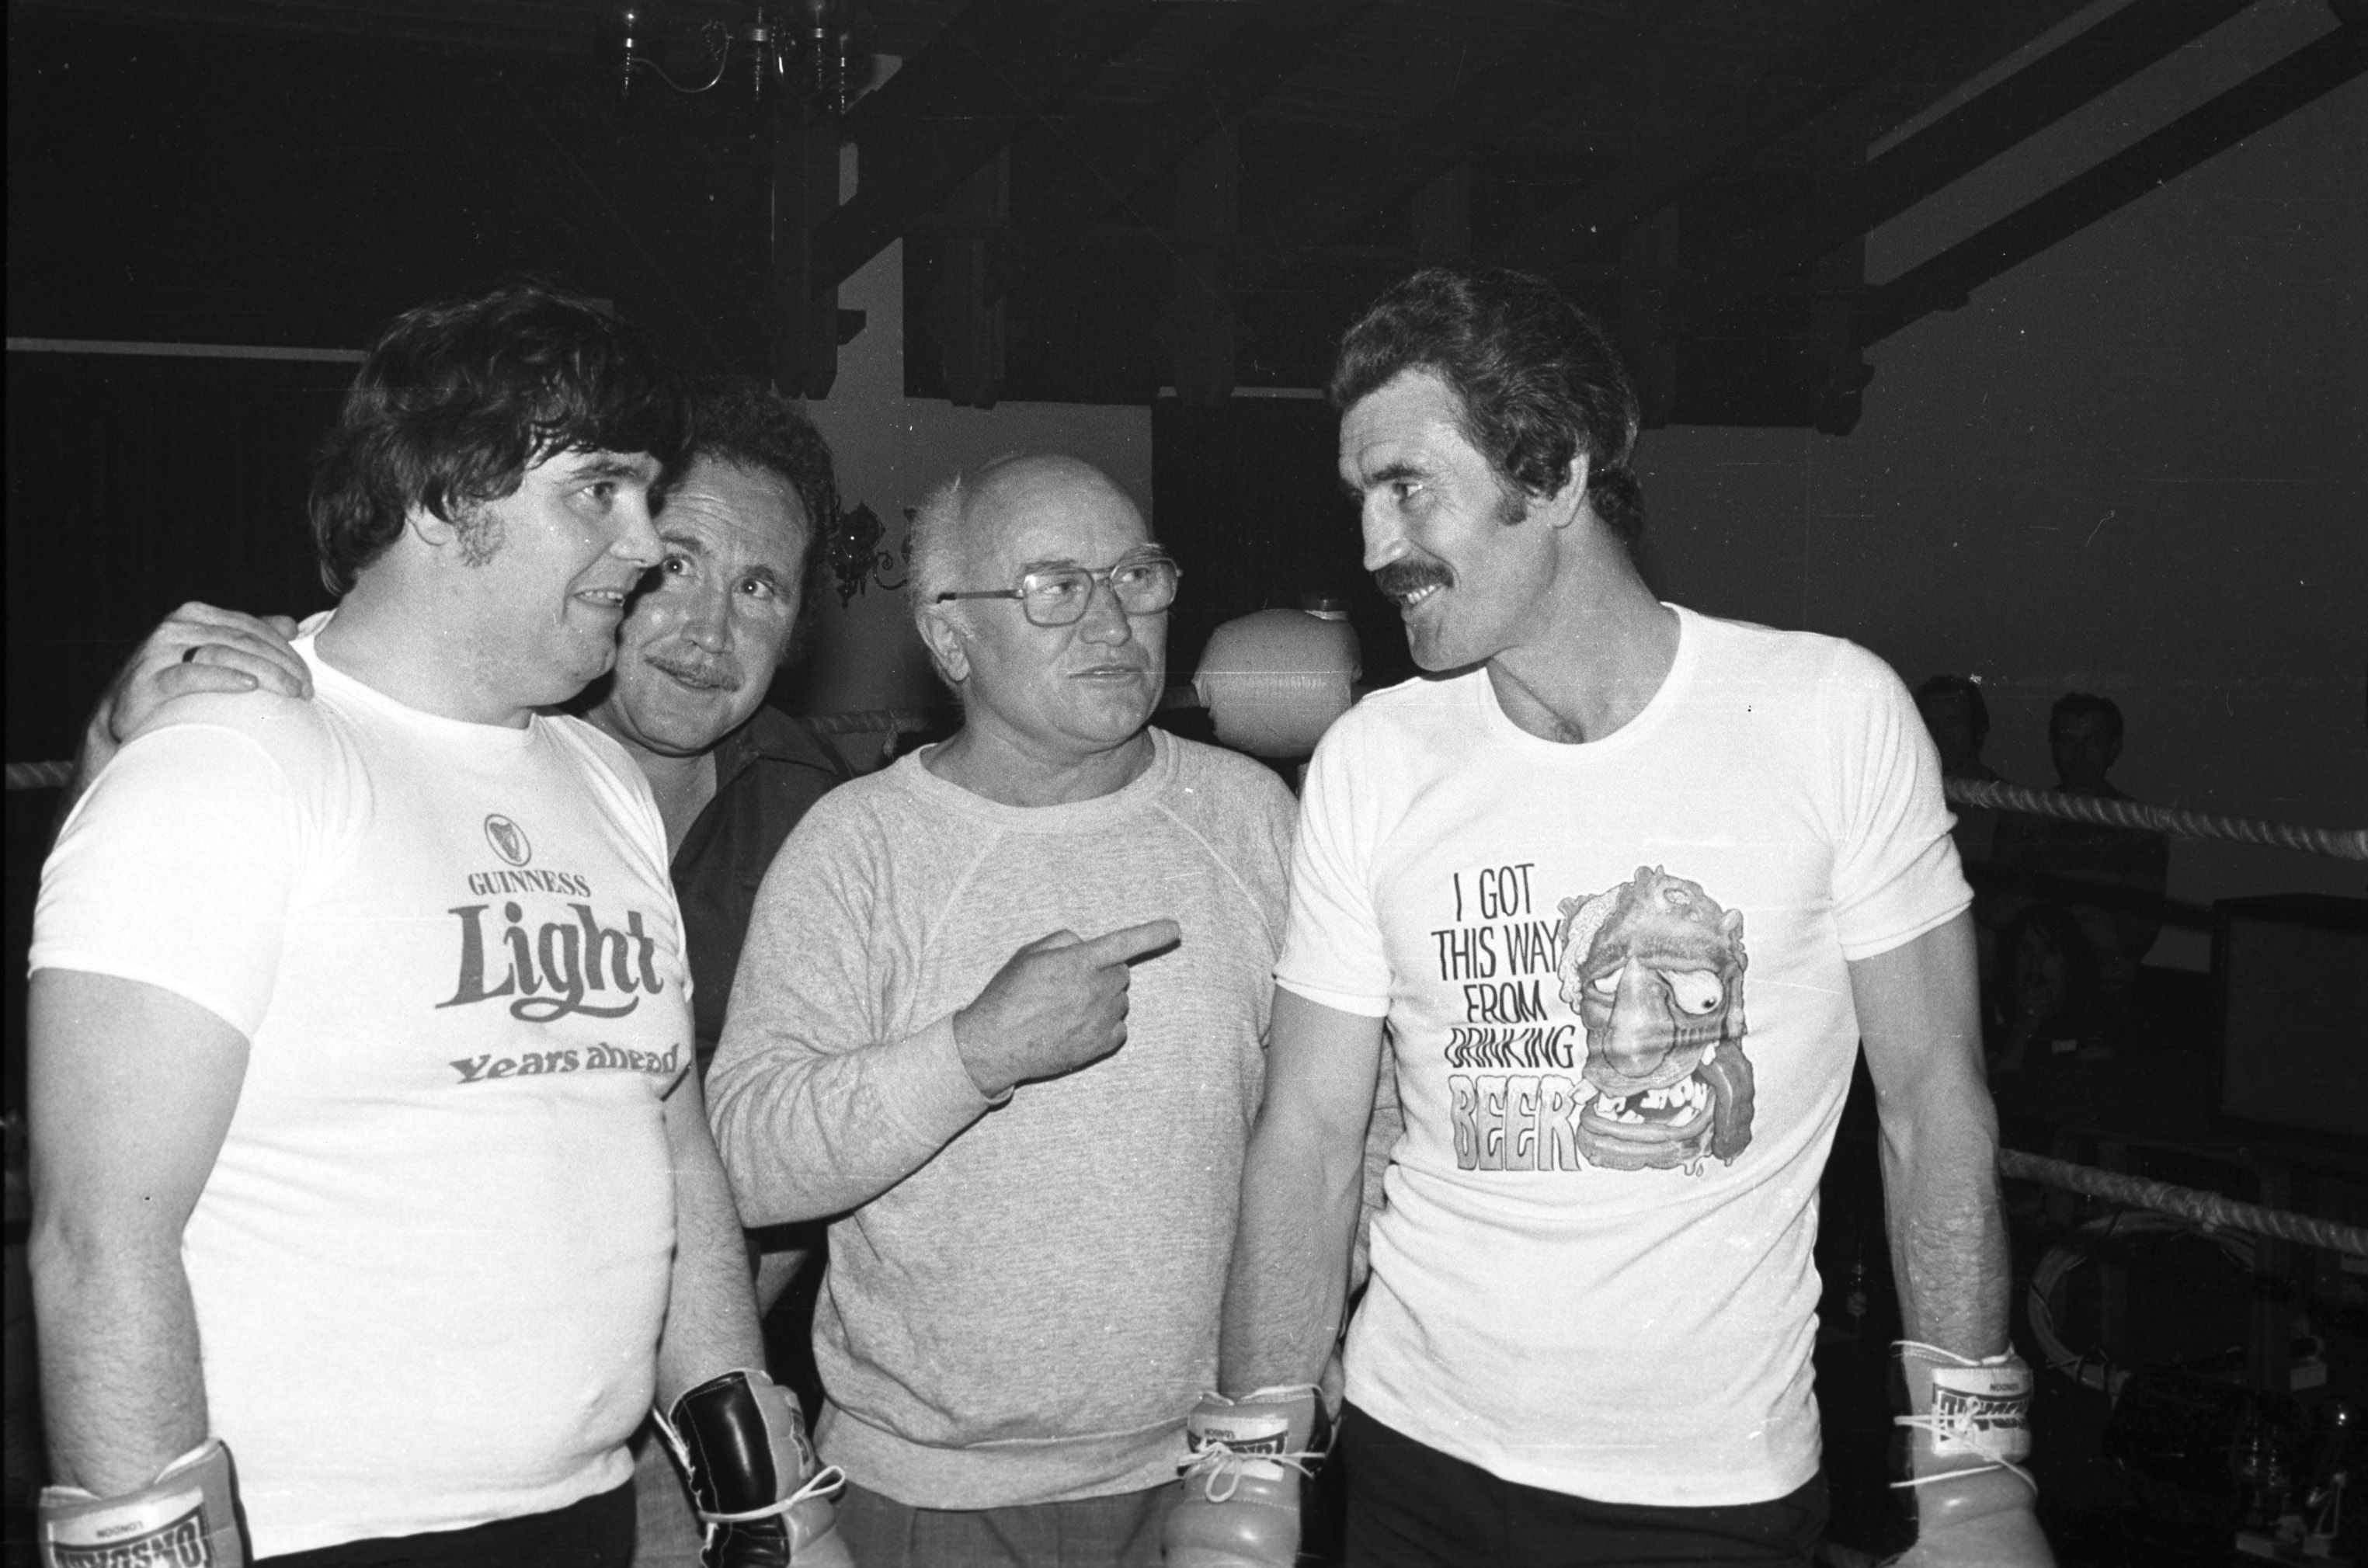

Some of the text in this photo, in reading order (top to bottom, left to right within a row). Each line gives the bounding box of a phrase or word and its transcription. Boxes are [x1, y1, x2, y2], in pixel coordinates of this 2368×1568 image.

[468, 868, 592, 898] GUINNESS
[1452, 863, 1535, 922] I GOT
[434, 900, 664, 1024] Light
[1431, 918, 1562, 981] THIS WAY
[1463, 979, 1549, 1024] FROM
[586, 1041, 680, 1074] ahead
[1445, 1024, 1576, 1069] DRINKING
[1448, 1073, 1583, 1172] BEER
[96, 1520, 144, 1538] LONDON
